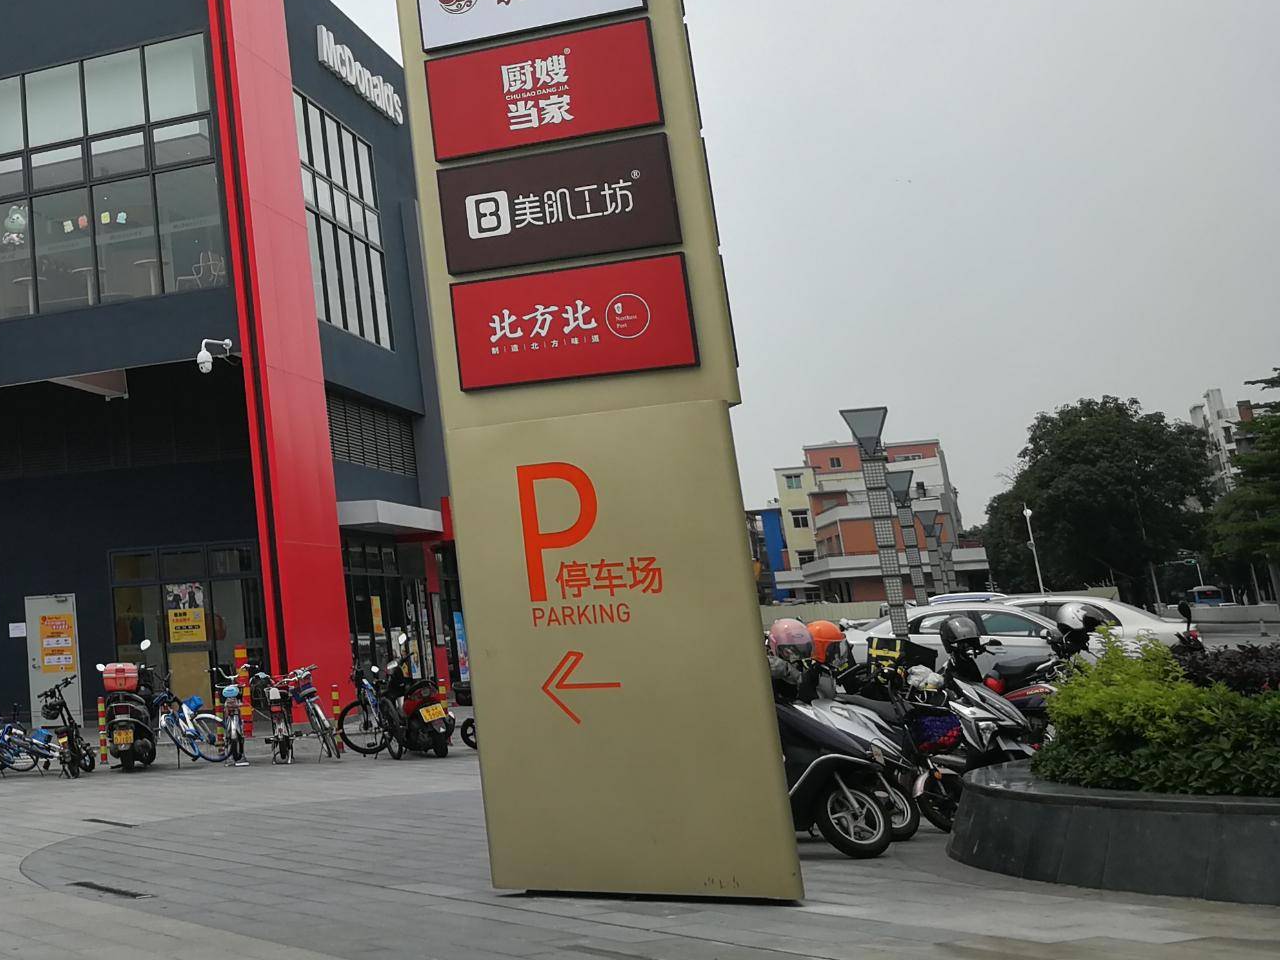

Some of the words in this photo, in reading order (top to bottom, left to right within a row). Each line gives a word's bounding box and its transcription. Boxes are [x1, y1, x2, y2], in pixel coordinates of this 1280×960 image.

[501, 54, 569, 93] 厨嫂
[507, 94, 575, 131] 当家
[514, 179, 635, 229] 美肌工坊
[488, 299, 598, 343] 北方北
[555, 556, 663, 600] 停车场
[531, 602, 631, 628] PARKING
